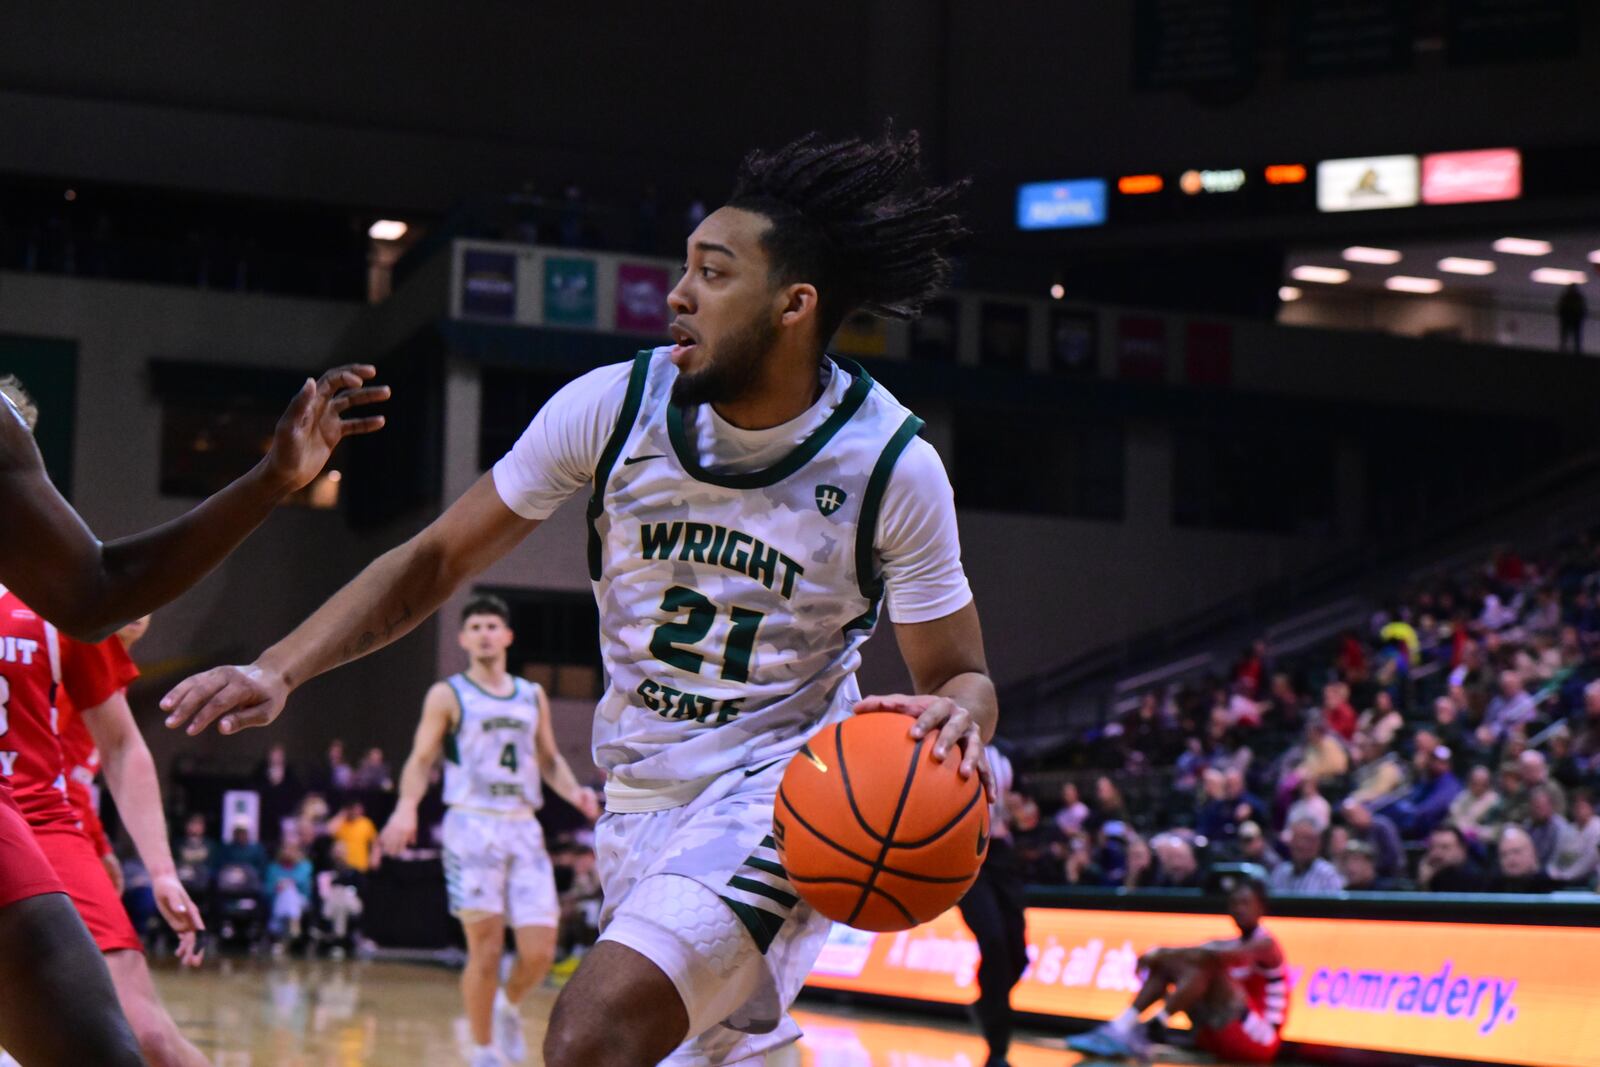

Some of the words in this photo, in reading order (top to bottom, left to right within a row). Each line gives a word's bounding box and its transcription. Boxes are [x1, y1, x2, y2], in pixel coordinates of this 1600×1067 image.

[640, 521, 804, 600] WRIGHT
[648, 585, 765, 683] 21
[636, 678, 747, 723] STATE
[500, 741, 518, 774] 4
[1307, 957, 1516, 1035] comradery.
